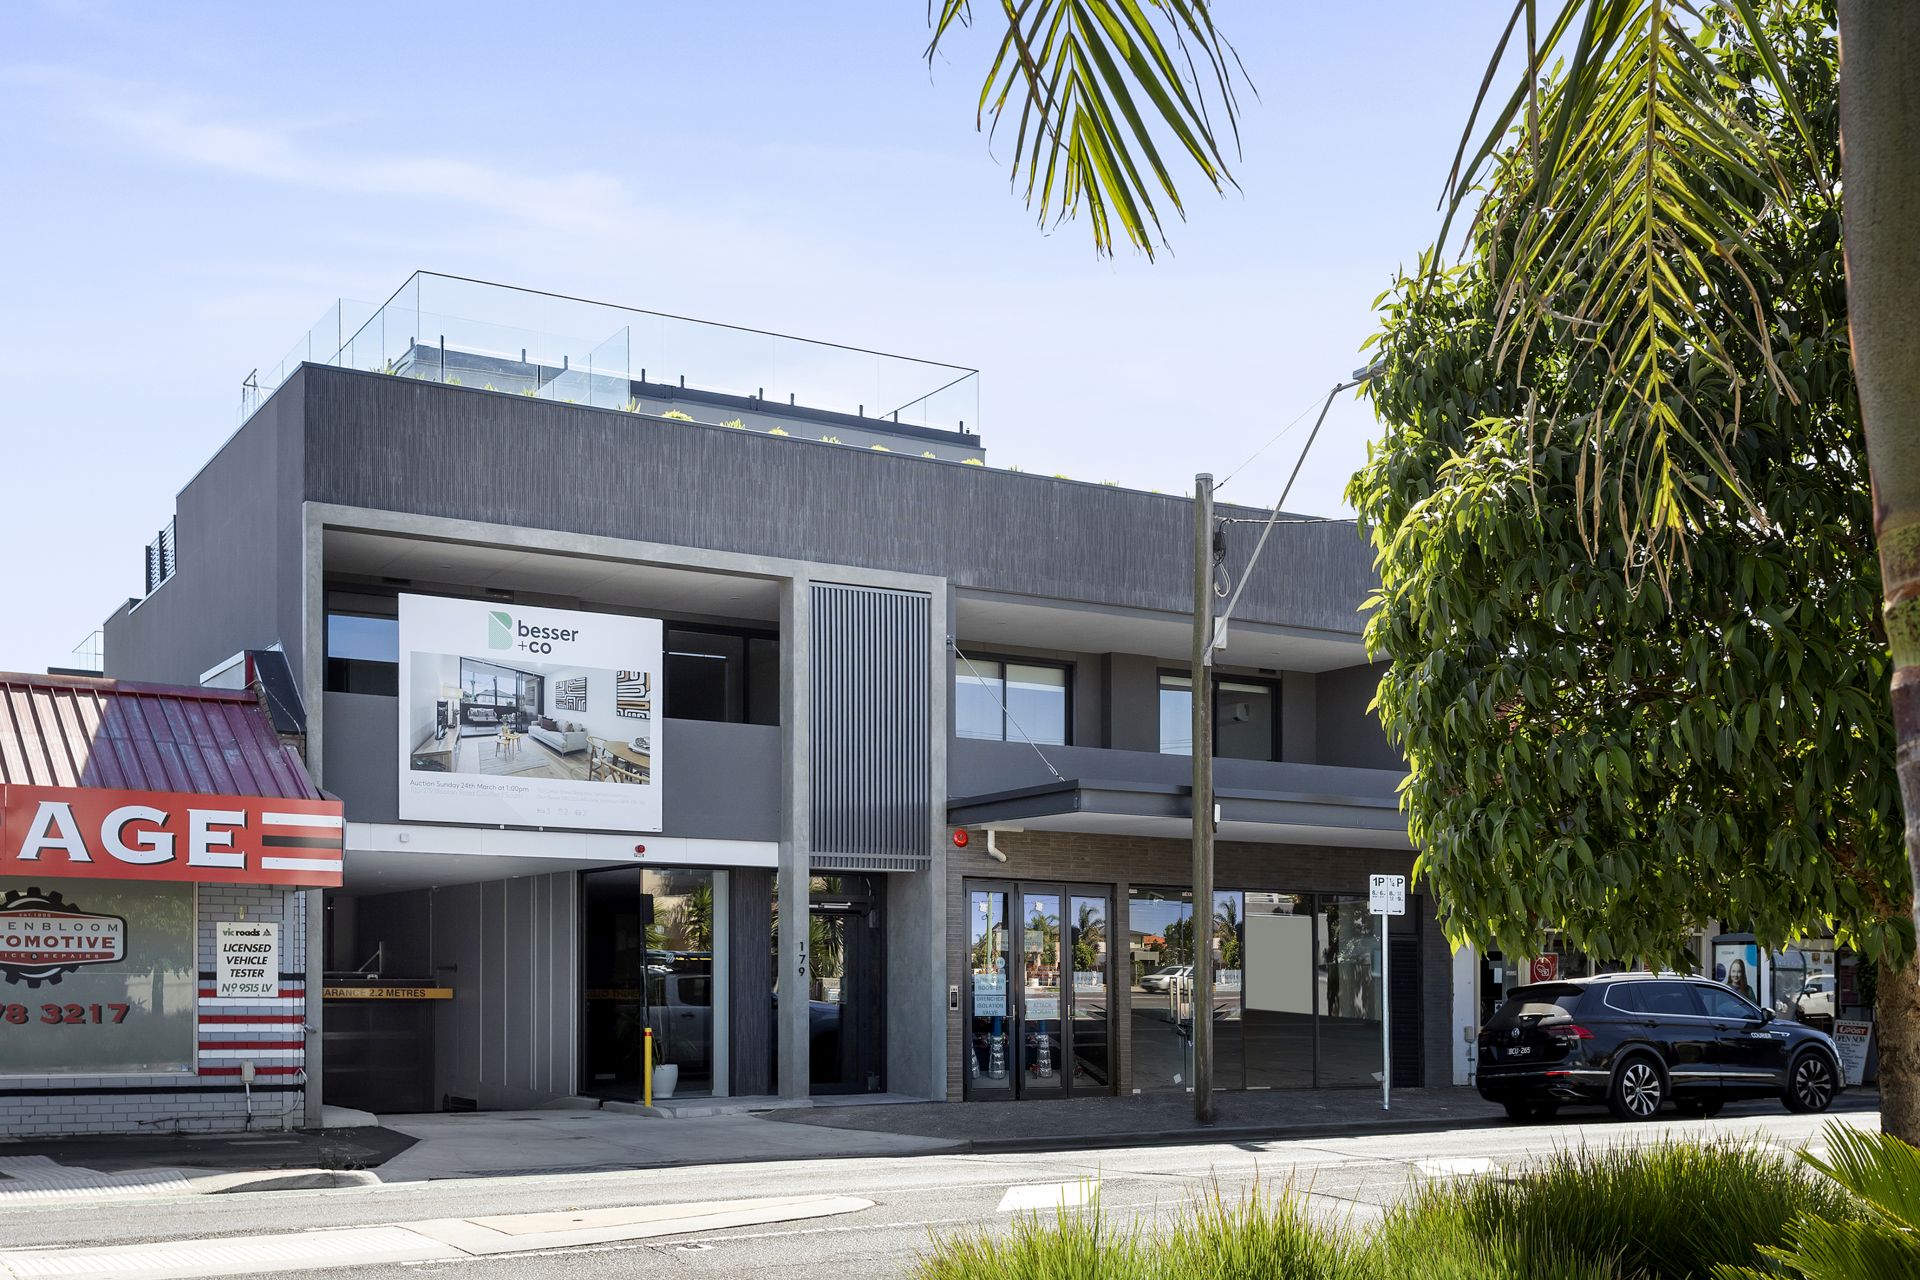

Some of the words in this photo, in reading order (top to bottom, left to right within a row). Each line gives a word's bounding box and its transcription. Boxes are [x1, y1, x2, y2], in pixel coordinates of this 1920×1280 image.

[518, 620, 579, 642] besser
[410, 779, 435, 787] Auction
[436, 781, 459, 789] Sunday
[477, 783, 497, 791] March
[16, 800, 249, 870] AGE
[1373, 877, 1385, 886] 1P
[8, 922, 118, 932] ENBLOOM
[236, 928, 260, 936] roads
[0, 935, 115, 949] OMOTIVE
[223, 943, 271, 952] LICENSED
[226, 956, 268, 965] VEHICLE
[798, 941, 806, 977] 179
[230, 968, 265, 978] TESTER
[239, 983, 259, 992] 9515
[261, 983, 273, 992] LV
[369, 989, 383, 997] 2.2
[386, 989, 426, 998] METRES
[40, 1003, 130, 1024] 3217
